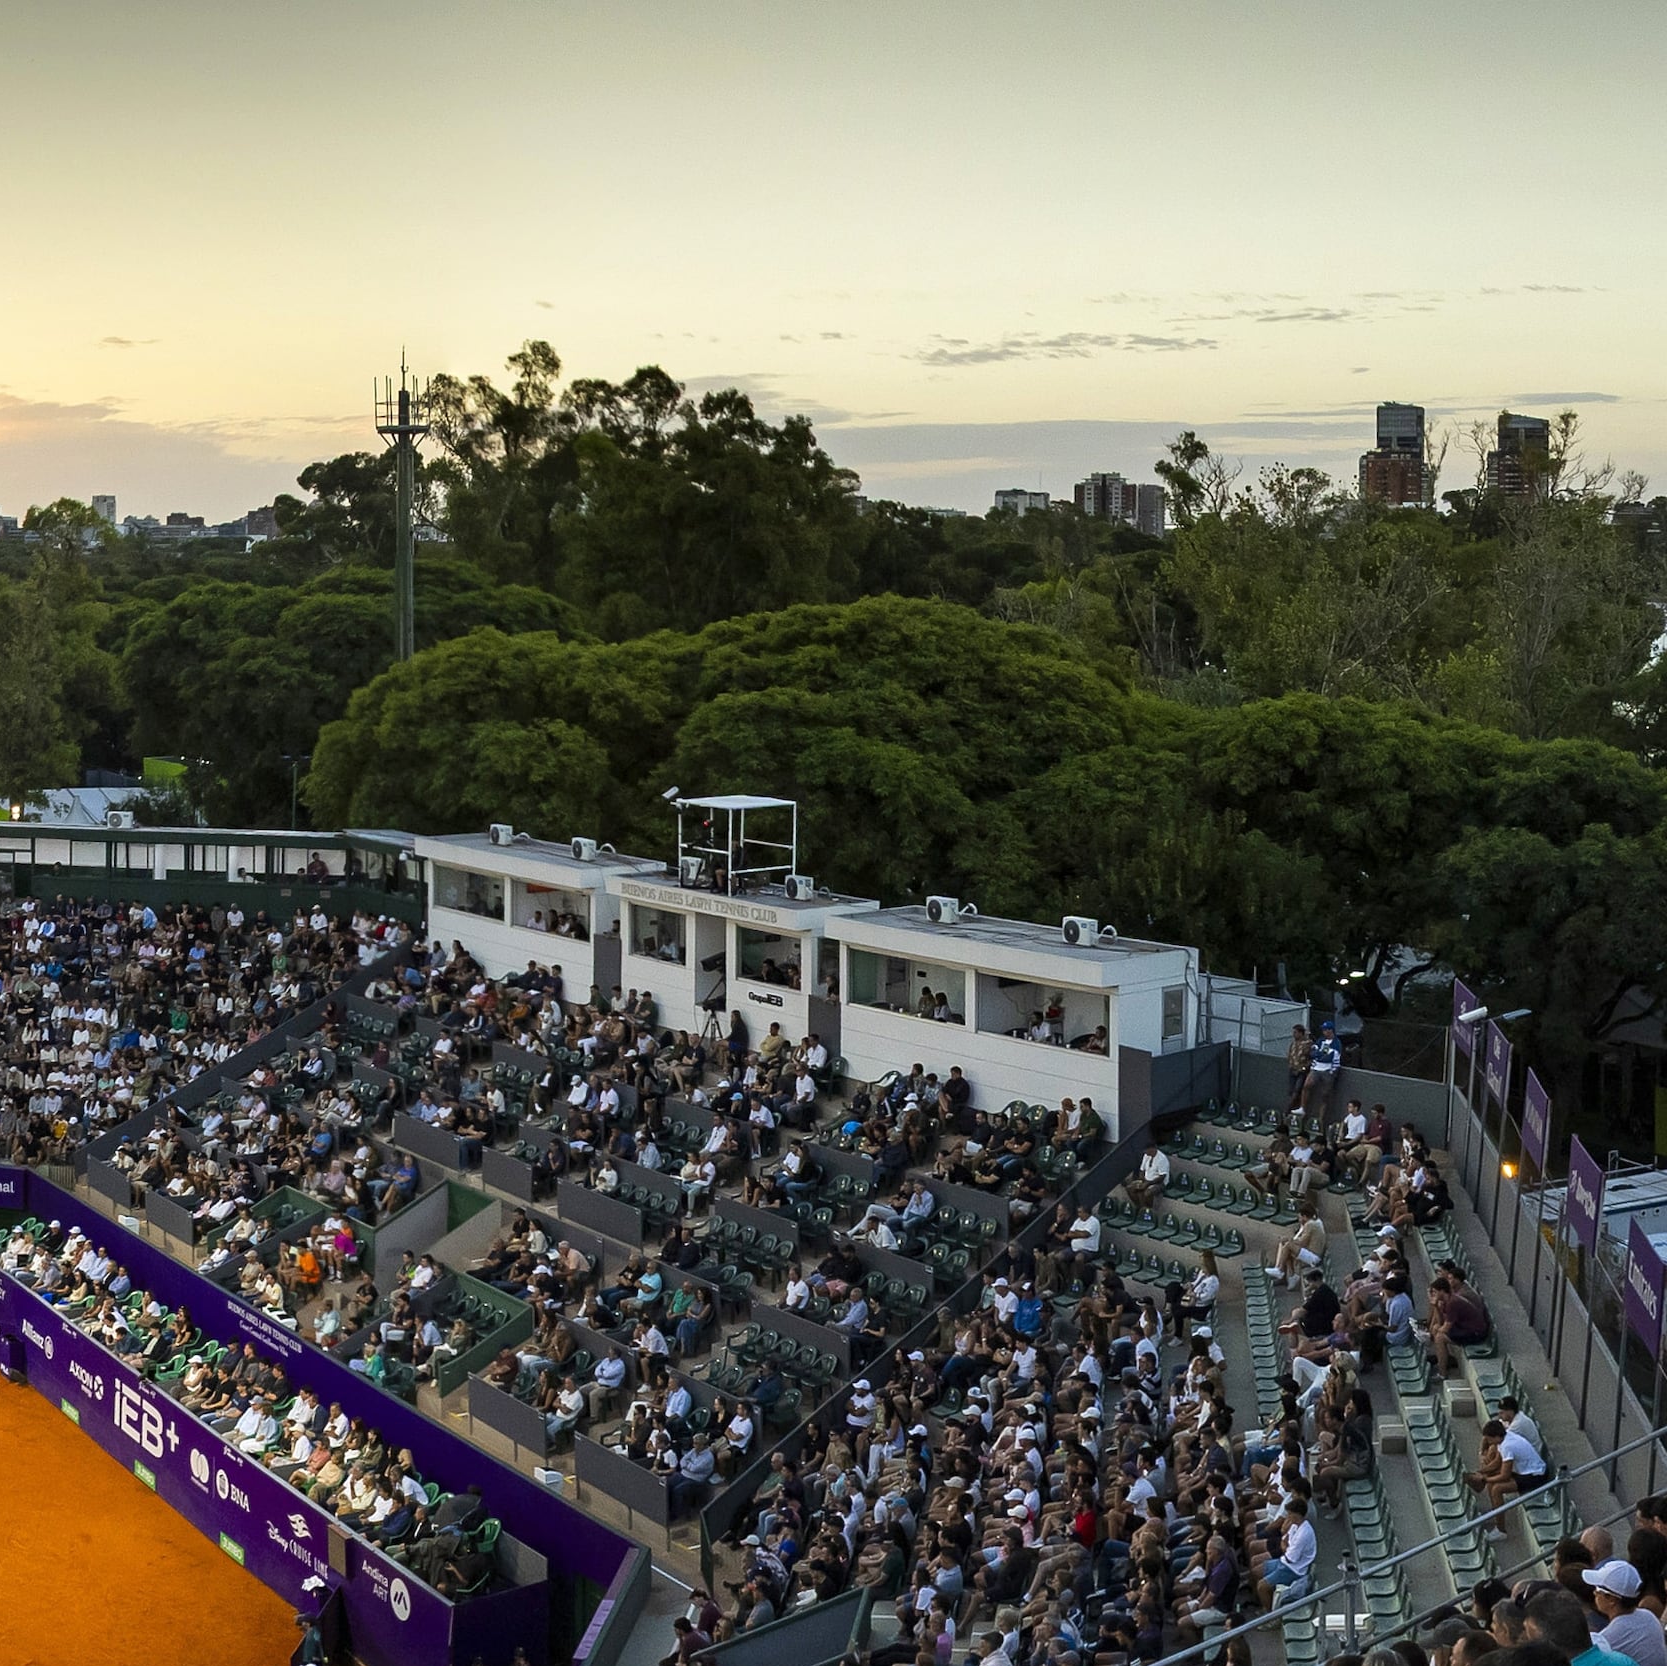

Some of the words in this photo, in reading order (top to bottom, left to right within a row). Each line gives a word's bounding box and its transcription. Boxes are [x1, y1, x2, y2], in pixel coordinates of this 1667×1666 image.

[621, 882, 657, 900] BUENOS
[658, 891, 684, 907] AIRES
[685, 896, 714, 911] LAWN
[714, 900, 749, 918] TENNIS
[751, 907, 778, 924] CLUB
[1628, 1250, 1658, 1321] Emirates
[22, 1318, 45, 1350] Allianz
[227, 1300, 246, 1318] BUENOS
[245, 1311, 259, 1327] AIRES
[259, 1319, 272, 1335] LAWN
[272, 1328, 289, 1346] TENNIS
[289, 1338, 302, 1353] CLUB
[69, 1360, 94, 1390] AXION
[230, 1483, 250, 1513] BNA
[222, 1534, 244, 1560] JUMBO
[267, 1520, 289, 1552] Disney
[289, 1539, 312, 1567] CRUISE
[313, 1556, 329, 1580] LINE
[362, 1559, 389, 1588] Andina
[372, 1583, 388, 1602] ART
